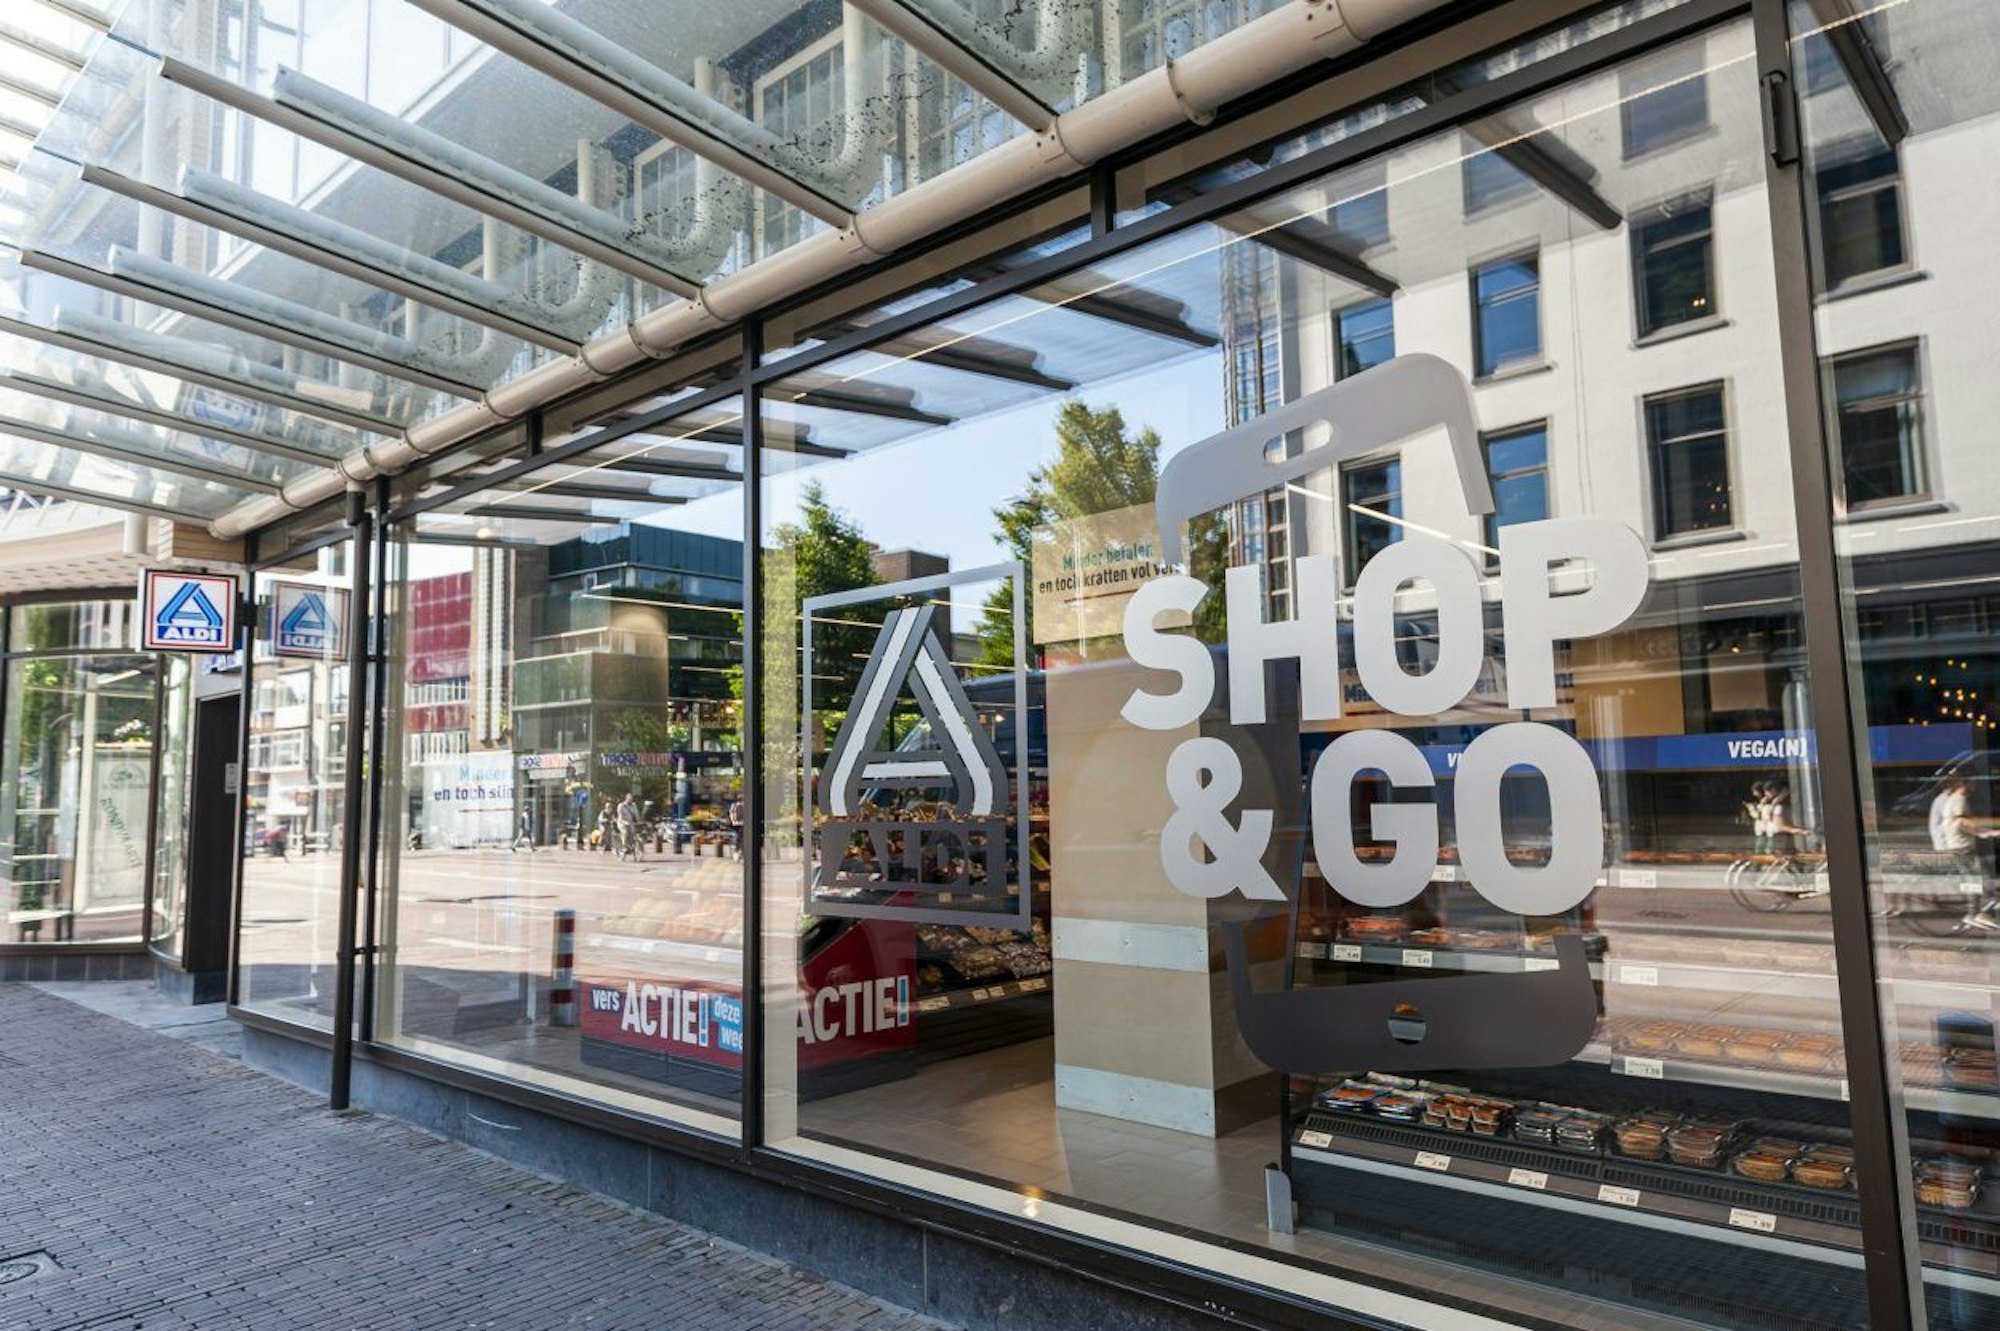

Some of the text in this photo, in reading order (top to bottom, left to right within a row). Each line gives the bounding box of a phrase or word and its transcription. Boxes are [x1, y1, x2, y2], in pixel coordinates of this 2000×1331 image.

[1062, 551, 1103, 572] Mider
[1039, 580, 1053, 594] en
[1084, 567, 1128, 588] kratten
[1131, 561, 1151, 580] vol
[1153, 562, 1186, 577] ver
[163, 628, 218, 641] ALDI
[1119, 516, 1649, 730] SHOP
[1728, 737, 1807, 759] VEGA(N)
[434, 788, 451, 801] en
[1159, 722, 1603, 916] & GO
[836, 829, 988, 886] ALDI
[592, 988, 621, 1013] vers
[621, 981, 710, 1048] ACTIE!
[714, 996, 740, 1025] deze
[798, 975, 910, 1045] ACTIE!
